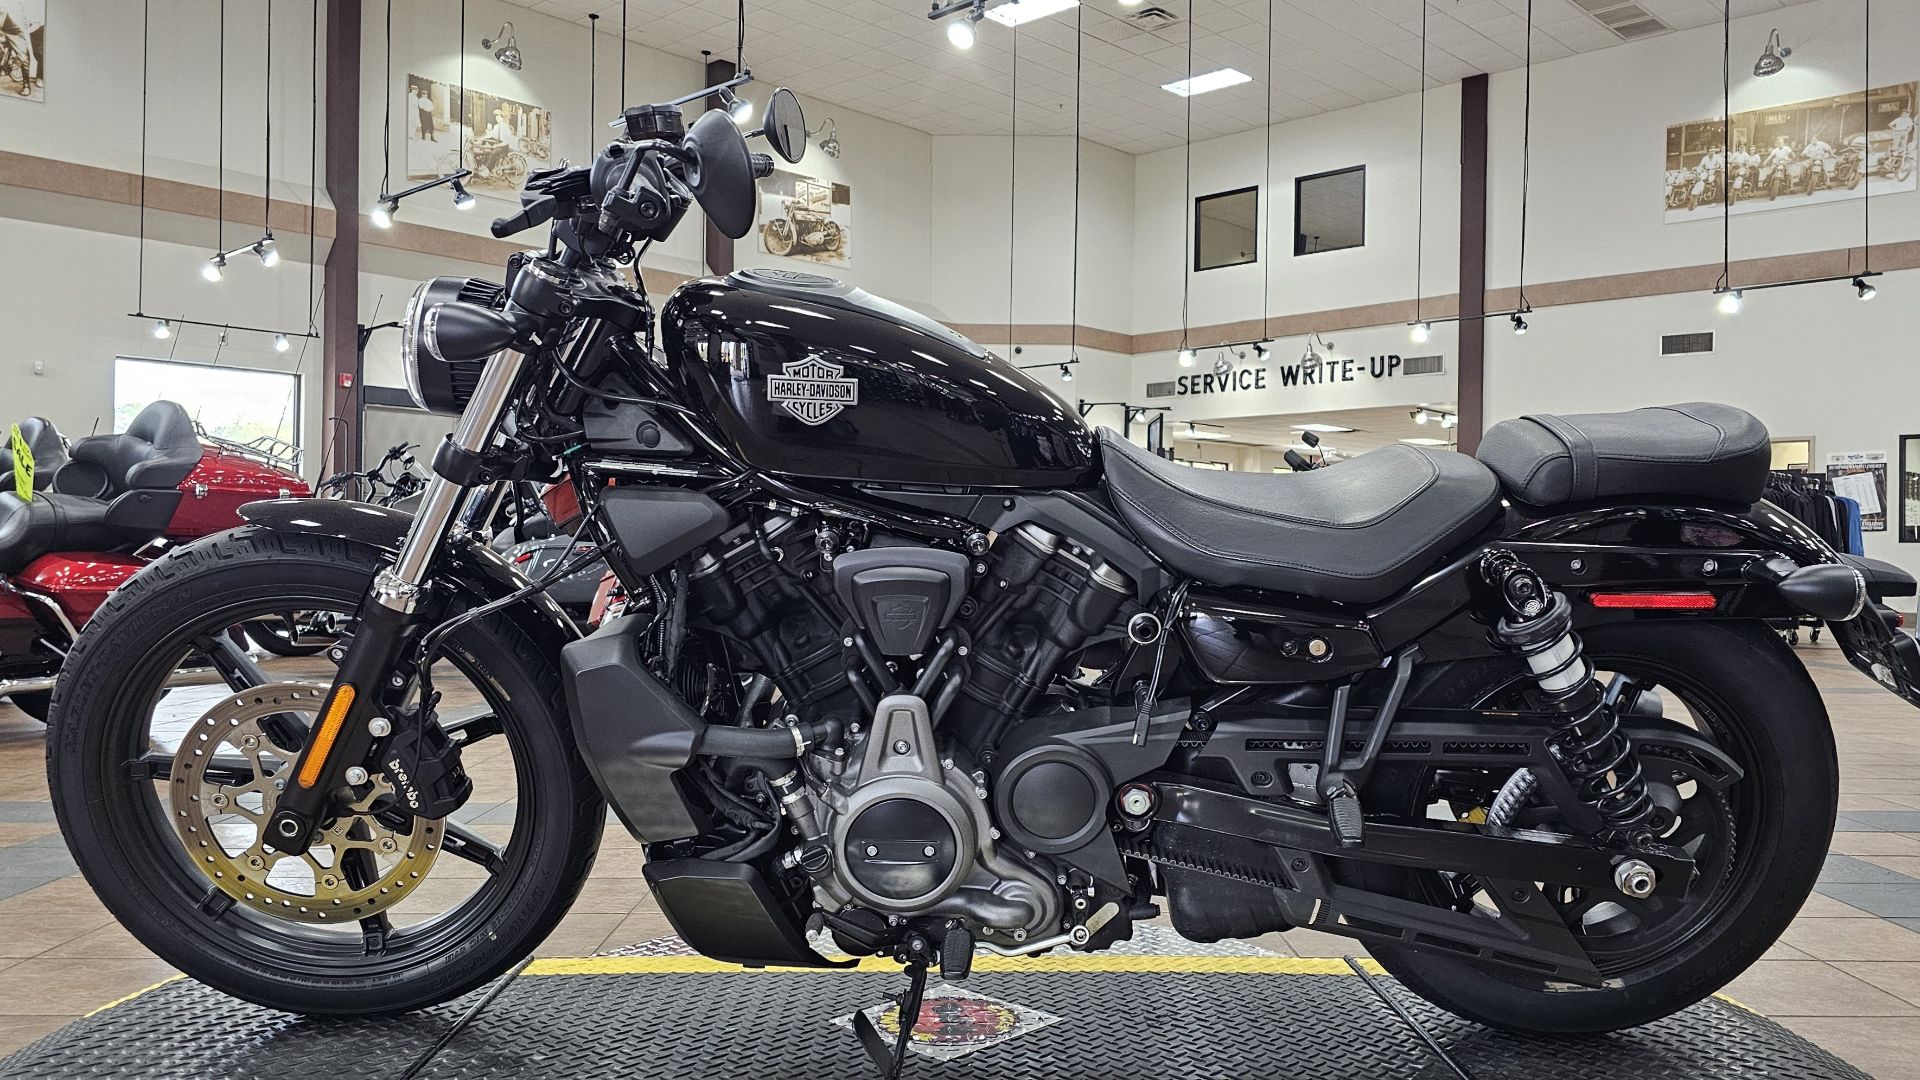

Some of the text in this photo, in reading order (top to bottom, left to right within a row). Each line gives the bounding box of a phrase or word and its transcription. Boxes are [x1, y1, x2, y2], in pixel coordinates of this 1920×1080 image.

[793, 363, 834, 379] MOTOR
[1176, 353, 1402, 396] SERVICE WRITE-UP
[774, 381, 852, 399] HARLEY-DAVIDSON
[792, 401, 834, 420] CYCLES
